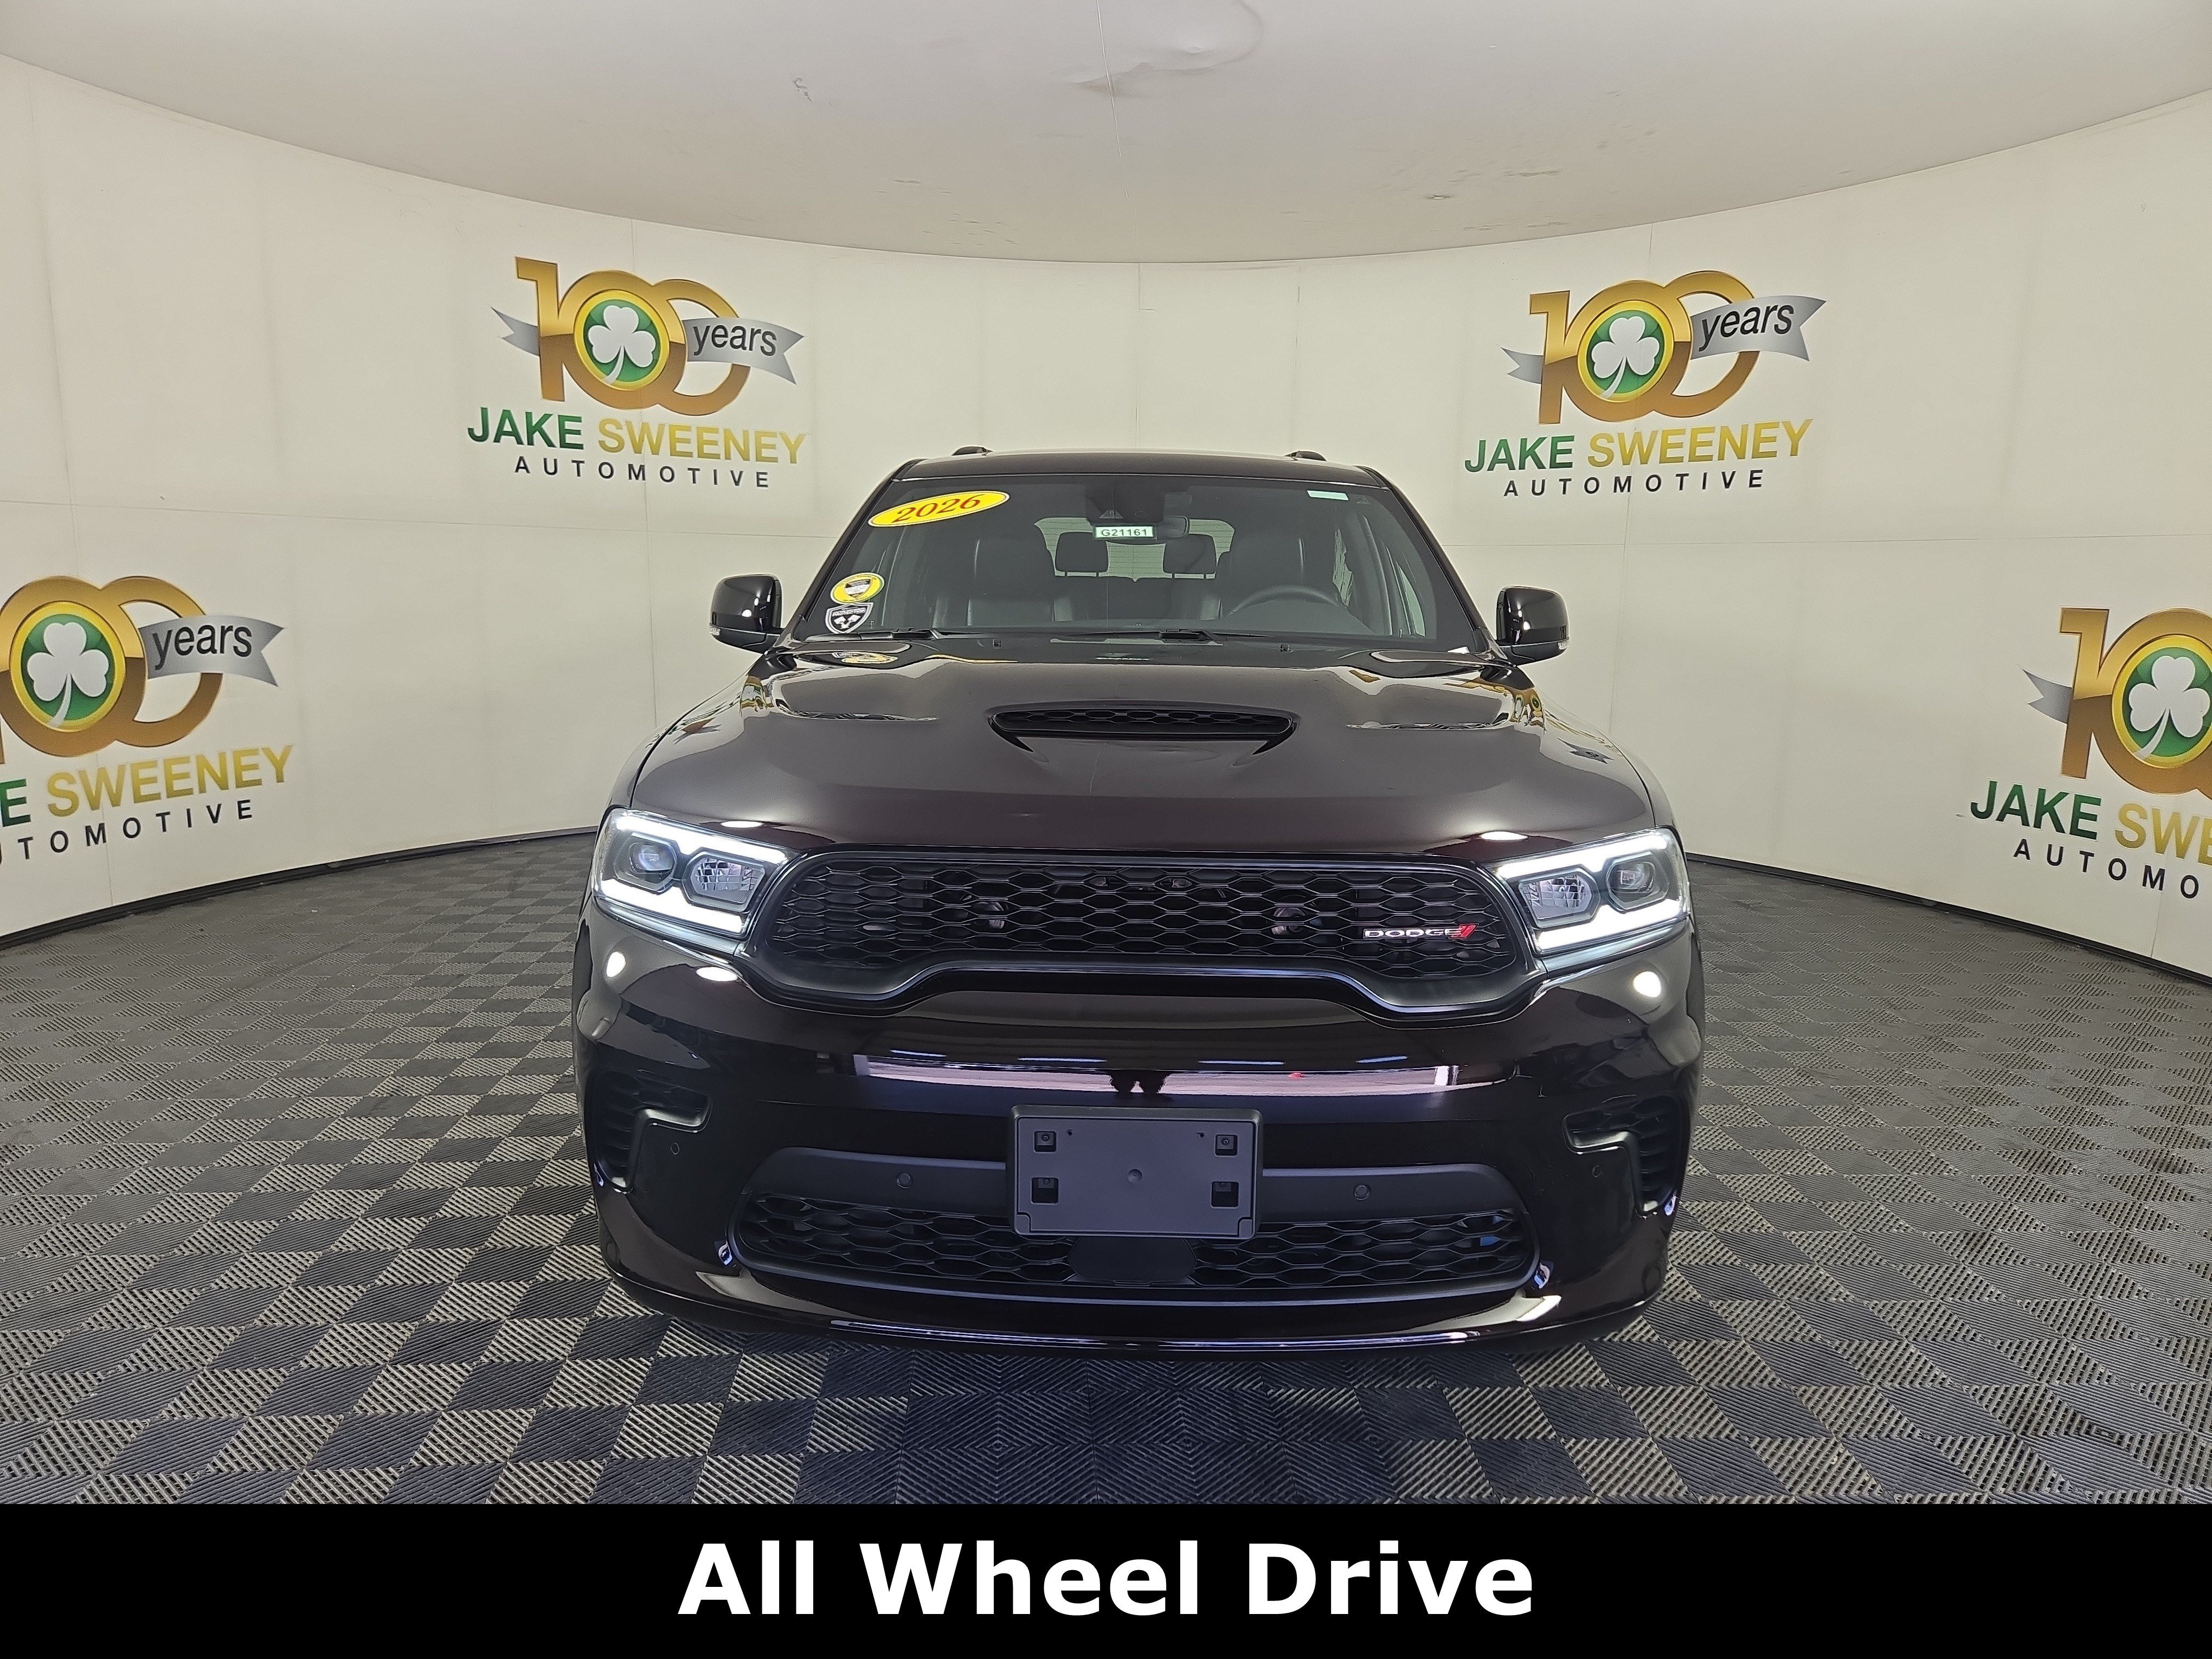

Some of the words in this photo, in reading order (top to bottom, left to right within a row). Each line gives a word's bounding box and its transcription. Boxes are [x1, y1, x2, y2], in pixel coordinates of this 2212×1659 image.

[693, 324, 777, 357] years
[1699, 301, 1795, 352] years
[468, 407, 584, 450] JAKE
[598, 418, 807, 465] SWEENEY
[1464, 435, 1574, 472] JAKE
[1587, 419, 1813, 467] SWEENEY
[515, 456, 769, 488] AUTOMOTIVE
[1503, 469, 1764, 497] AUTOMOTIVE
[891, 494, 986, 523] 2026
[152, 624, 253, 670] years
[47, 744, 293, 817] SWEENEY
[0, 799, 253, 865] TOMOTIVE
[1970, 780, 2101, 840] JAKE
[1365, 928, 1462, 937] DODGE
